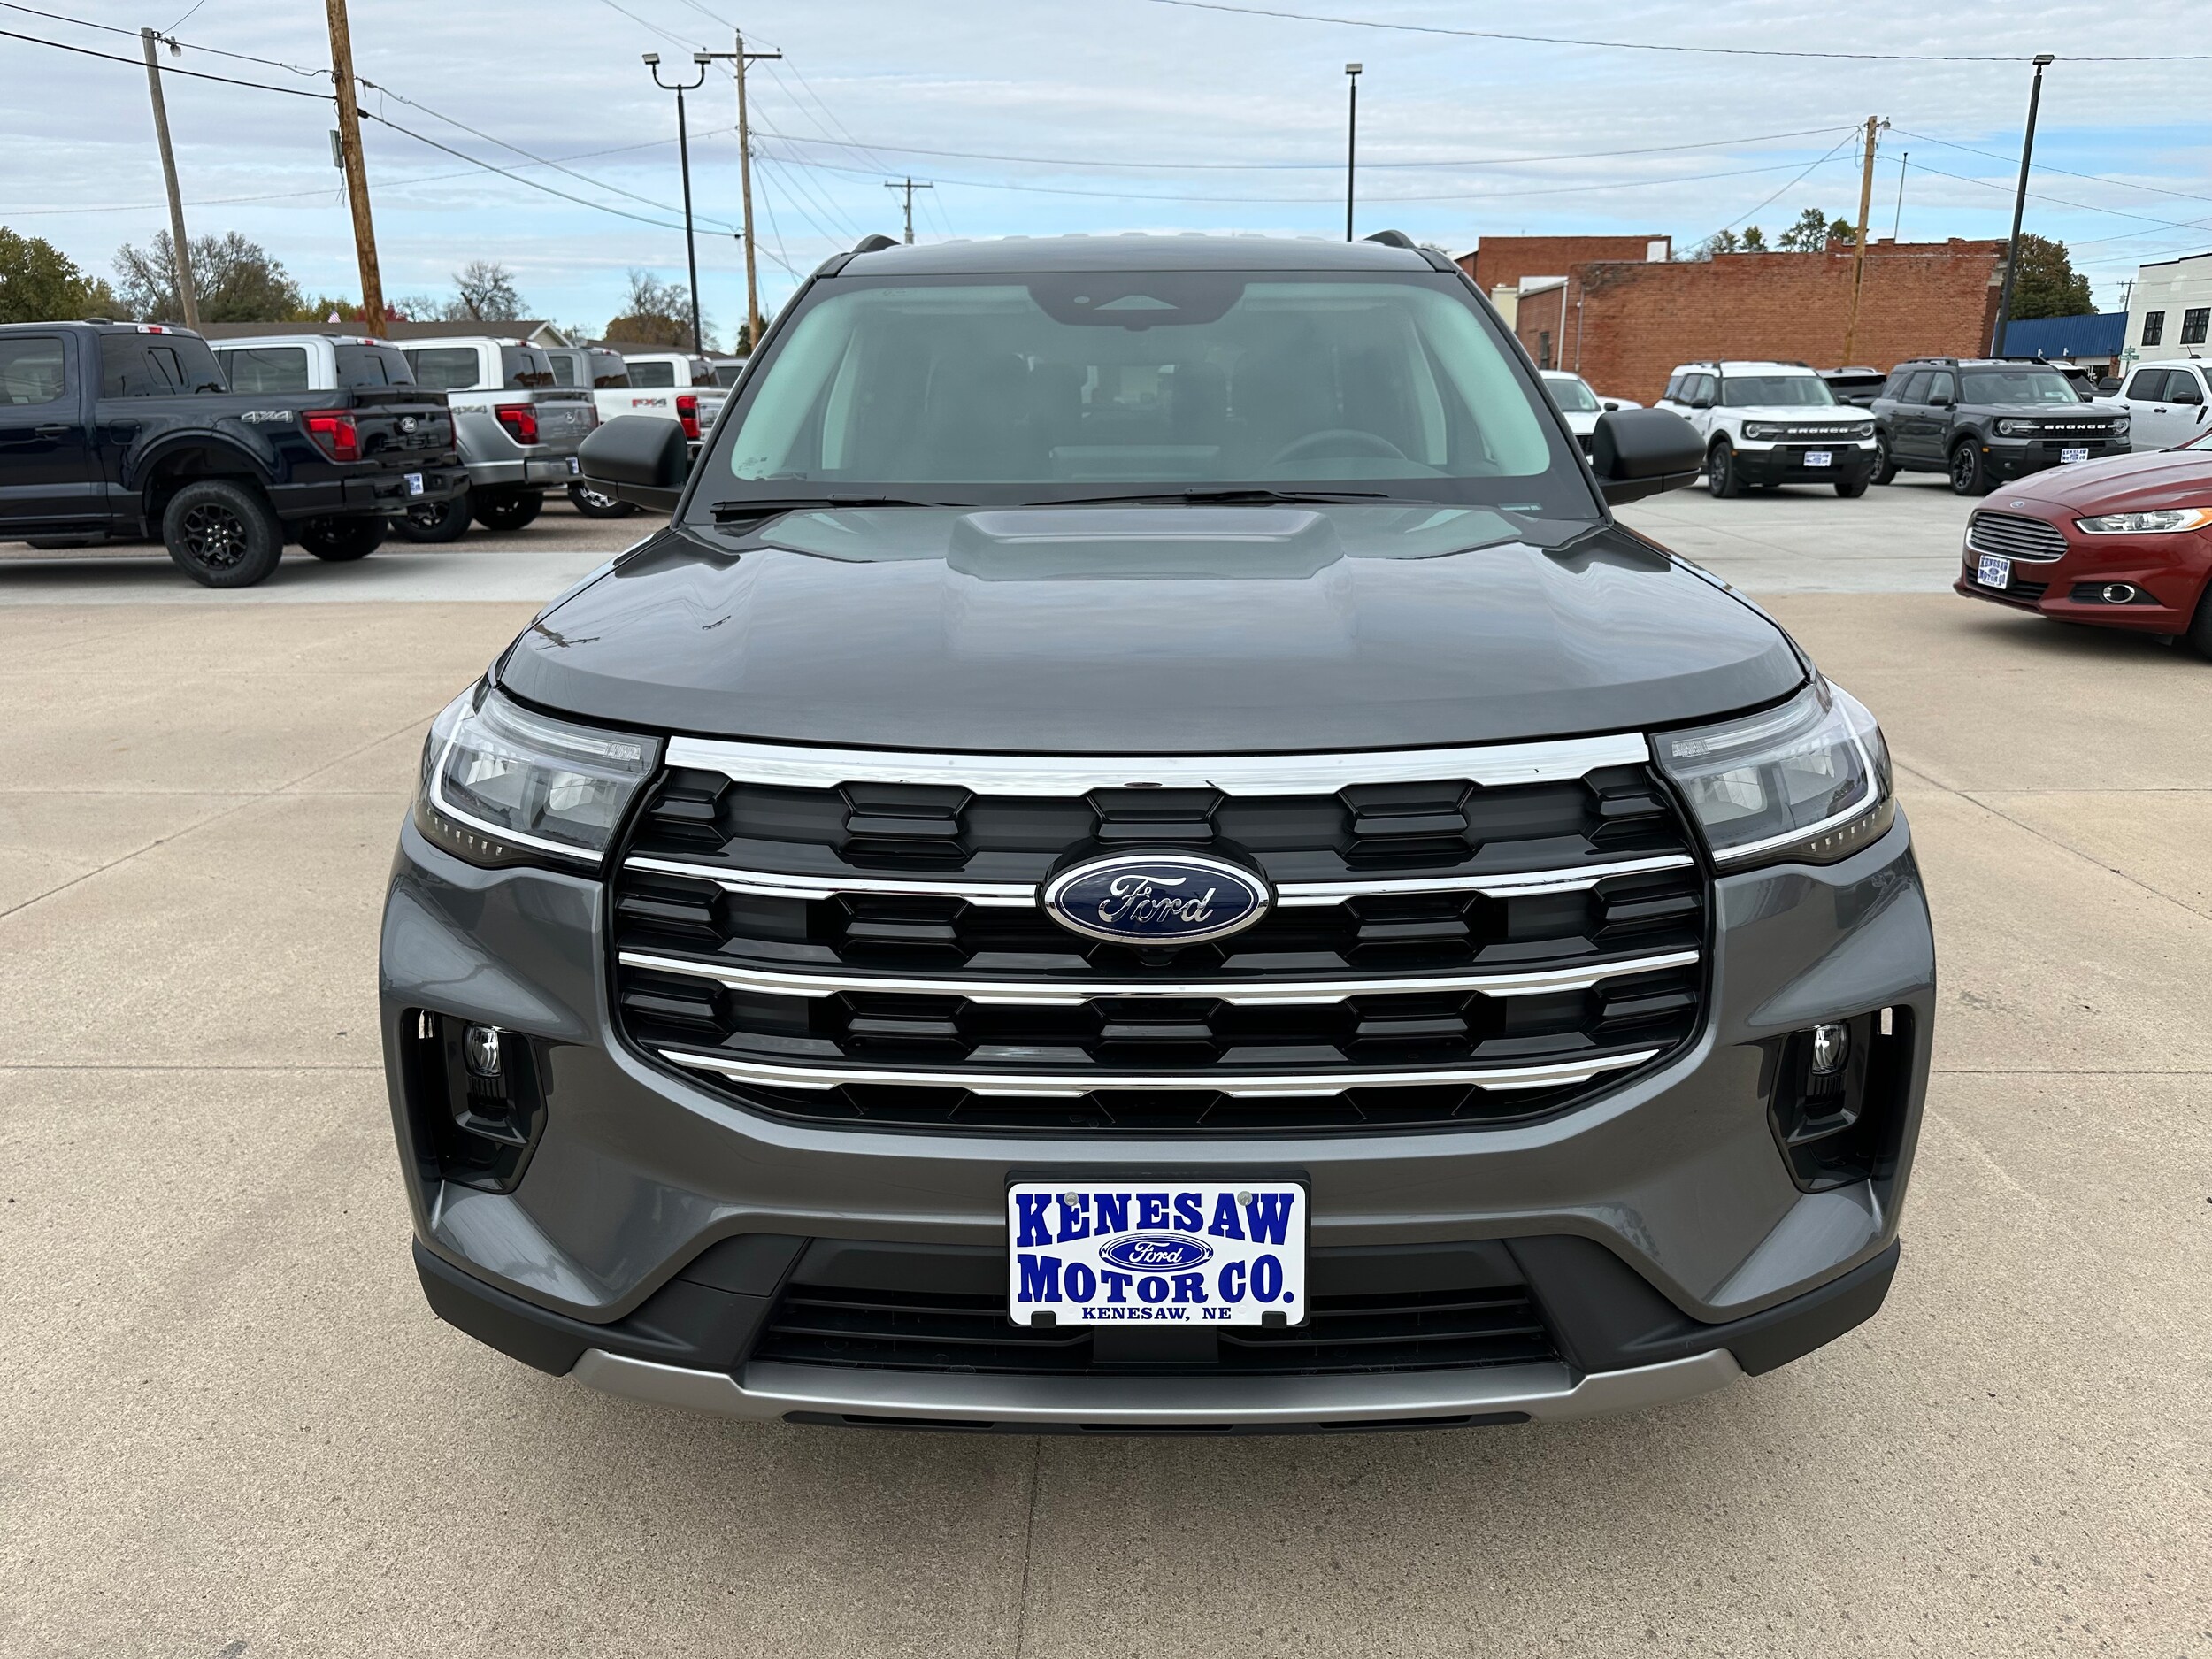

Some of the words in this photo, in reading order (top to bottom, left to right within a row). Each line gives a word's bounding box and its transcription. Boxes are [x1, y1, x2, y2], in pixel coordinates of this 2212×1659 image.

[632, 398, 667, 407] FX4
[1098, 874, 1217, 923] Ford
[1016, 1192, 1295, 1248] KENESAW
[1128, 1241, 1184, 1263] Ford
[1017, 1253, 1210, 1304] MOTOR
[1217, 1253, 1295, 1304] CO.
[1081, 1307, 1191, 1322] KENESAW,
[1202, 1307, 1233, 1320] NE
